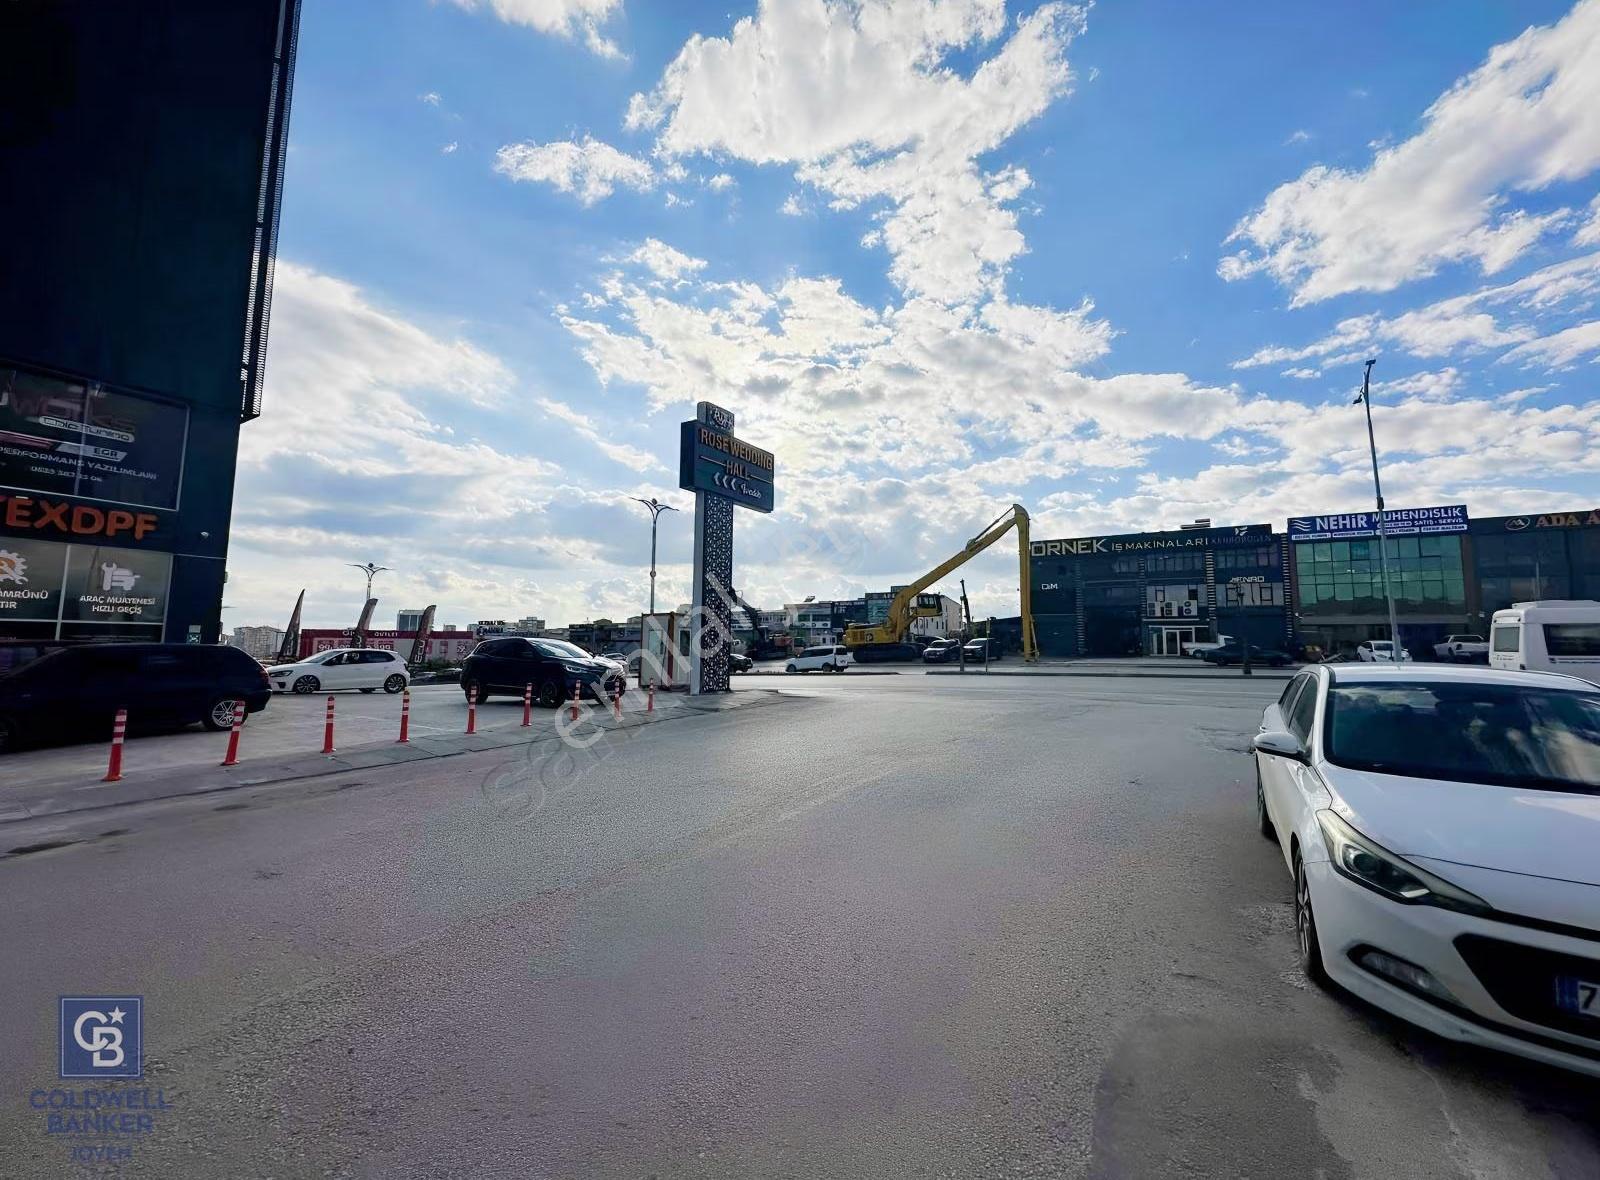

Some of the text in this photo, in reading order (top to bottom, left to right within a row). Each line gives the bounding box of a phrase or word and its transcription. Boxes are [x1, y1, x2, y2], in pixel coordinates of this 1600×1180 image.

[700, 428, 773, 470] ROSE WEDDING
[726, 461, 750, 480] HALL
